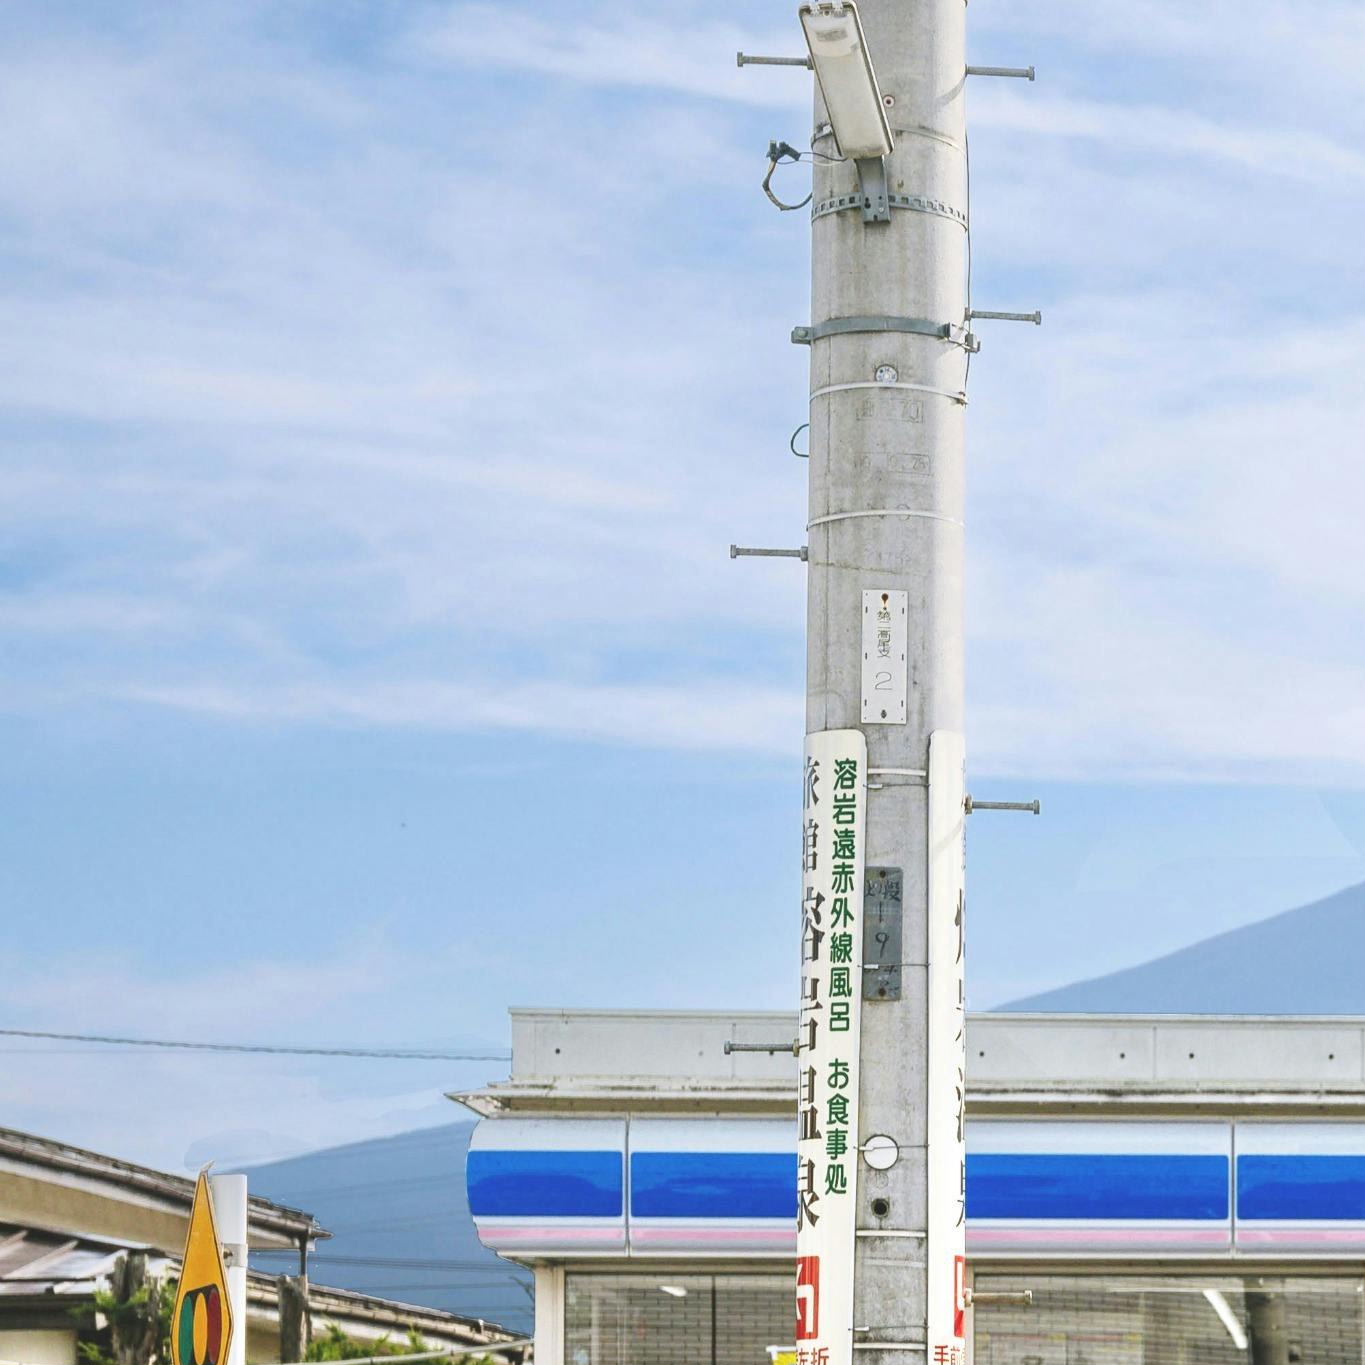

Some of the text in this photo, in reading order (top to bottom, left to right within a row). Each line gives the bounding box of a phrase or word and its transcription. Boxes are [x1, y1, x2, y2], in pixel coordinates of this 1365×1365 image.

[874, 671, 893, 691] 2
[825, 758, 858, 1196] 溶岩遠赤外線風呂 お食事処
